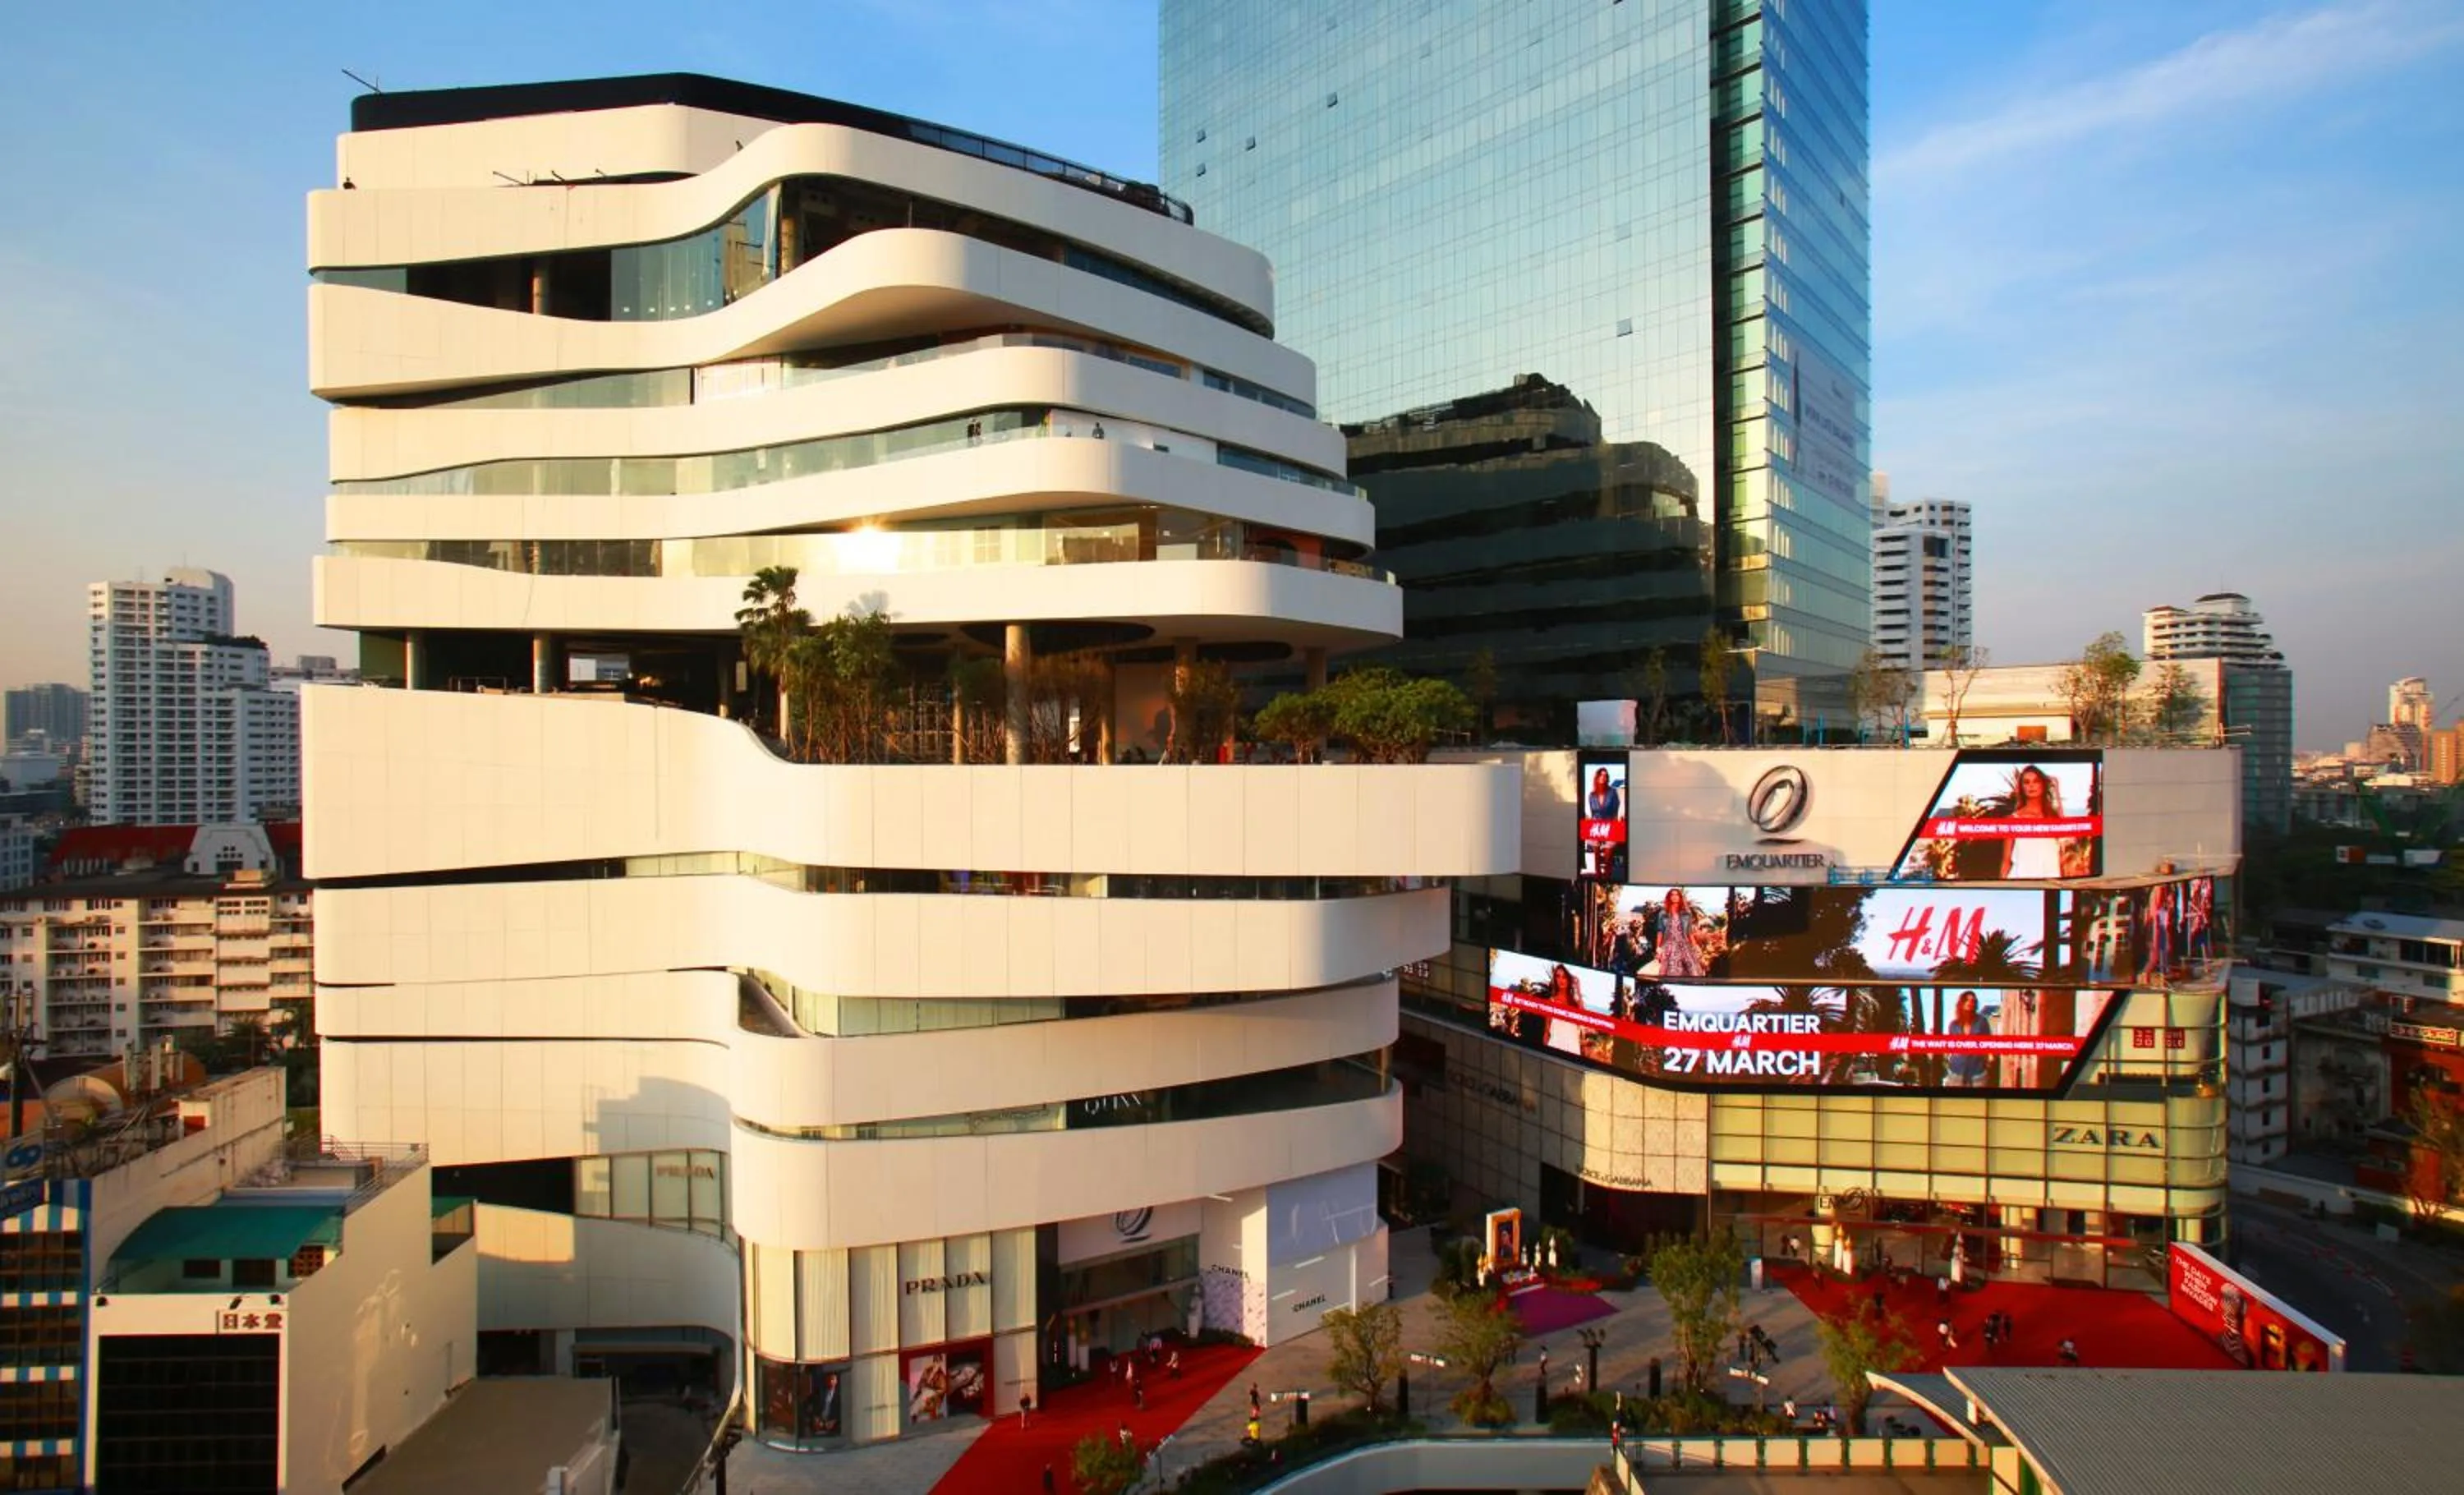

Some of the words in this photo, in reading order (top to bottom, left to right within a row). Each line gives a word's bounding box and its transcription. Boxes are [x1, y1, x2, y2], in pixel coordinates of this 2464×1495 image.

[1726, 853, 1827, 871] EMQUARTIER
[1888, 907, 1985, 964] H&M
[1663, 1011, 1820, 1034] EMQUARTIER
[1663, 1047, 1700, 1073] 27
[1707, 1051, 1820, 1075] MARCH
[2053, 1126, 2163, 1148] ZARA
[906, 1272, 988, 1295] PRADA
[1291, 1294, 1326, 1313] CHANEL
